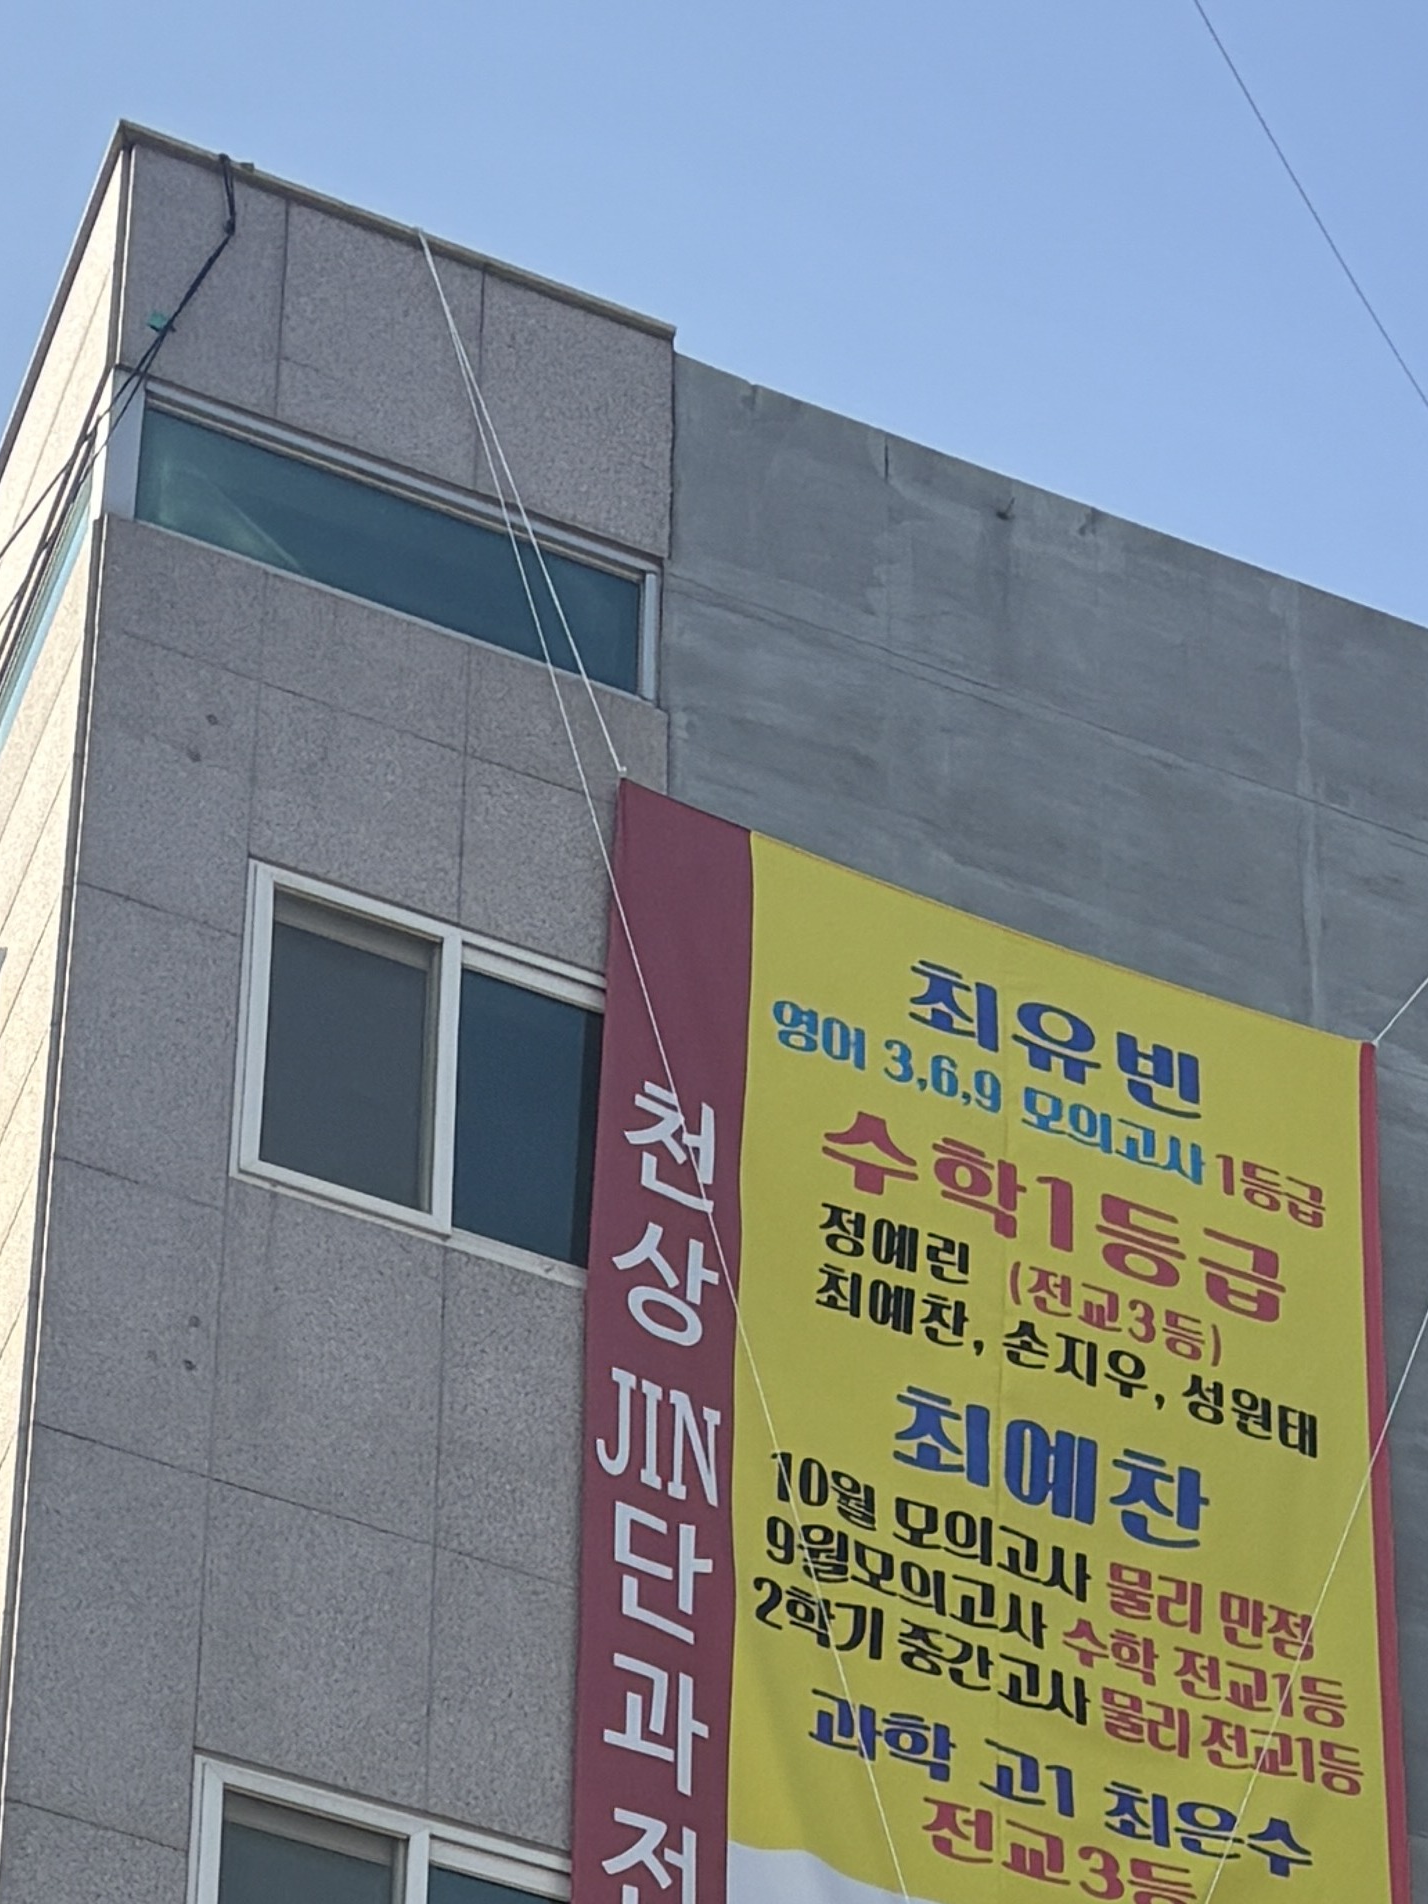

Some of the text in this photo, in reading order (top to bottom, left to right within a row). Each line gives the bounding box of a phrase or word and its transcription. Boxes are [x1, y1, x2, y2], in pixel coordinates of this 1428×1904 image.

[772, 1000, 1326, 1229] 영어 3,6,9 모의고사 1등급
[908, 959, 1202, 1119] 최유빈
[819, 1202, 1222, 1368] 정예린 (전교3등)
[822, 1110, 1287, 1323] 수학1등급
[815, 1263, 1318, 1459] 최예찬, 손지우, 성원태
[892, 1385, 1210, 1549] 최예찬
[771, 1451, 1315, 1662] 10월 모의고사 물리 만점
[753, 1576, 885, 1660] 2학기
[897, 1617, 1092, 1726] 중간고사
[1062, 1617, 1160, 1687] 수학
[1174, 1646, 1348, 1729] 전교1등
[808, 1688, 1313, 1878] 과학 고1 최은수
